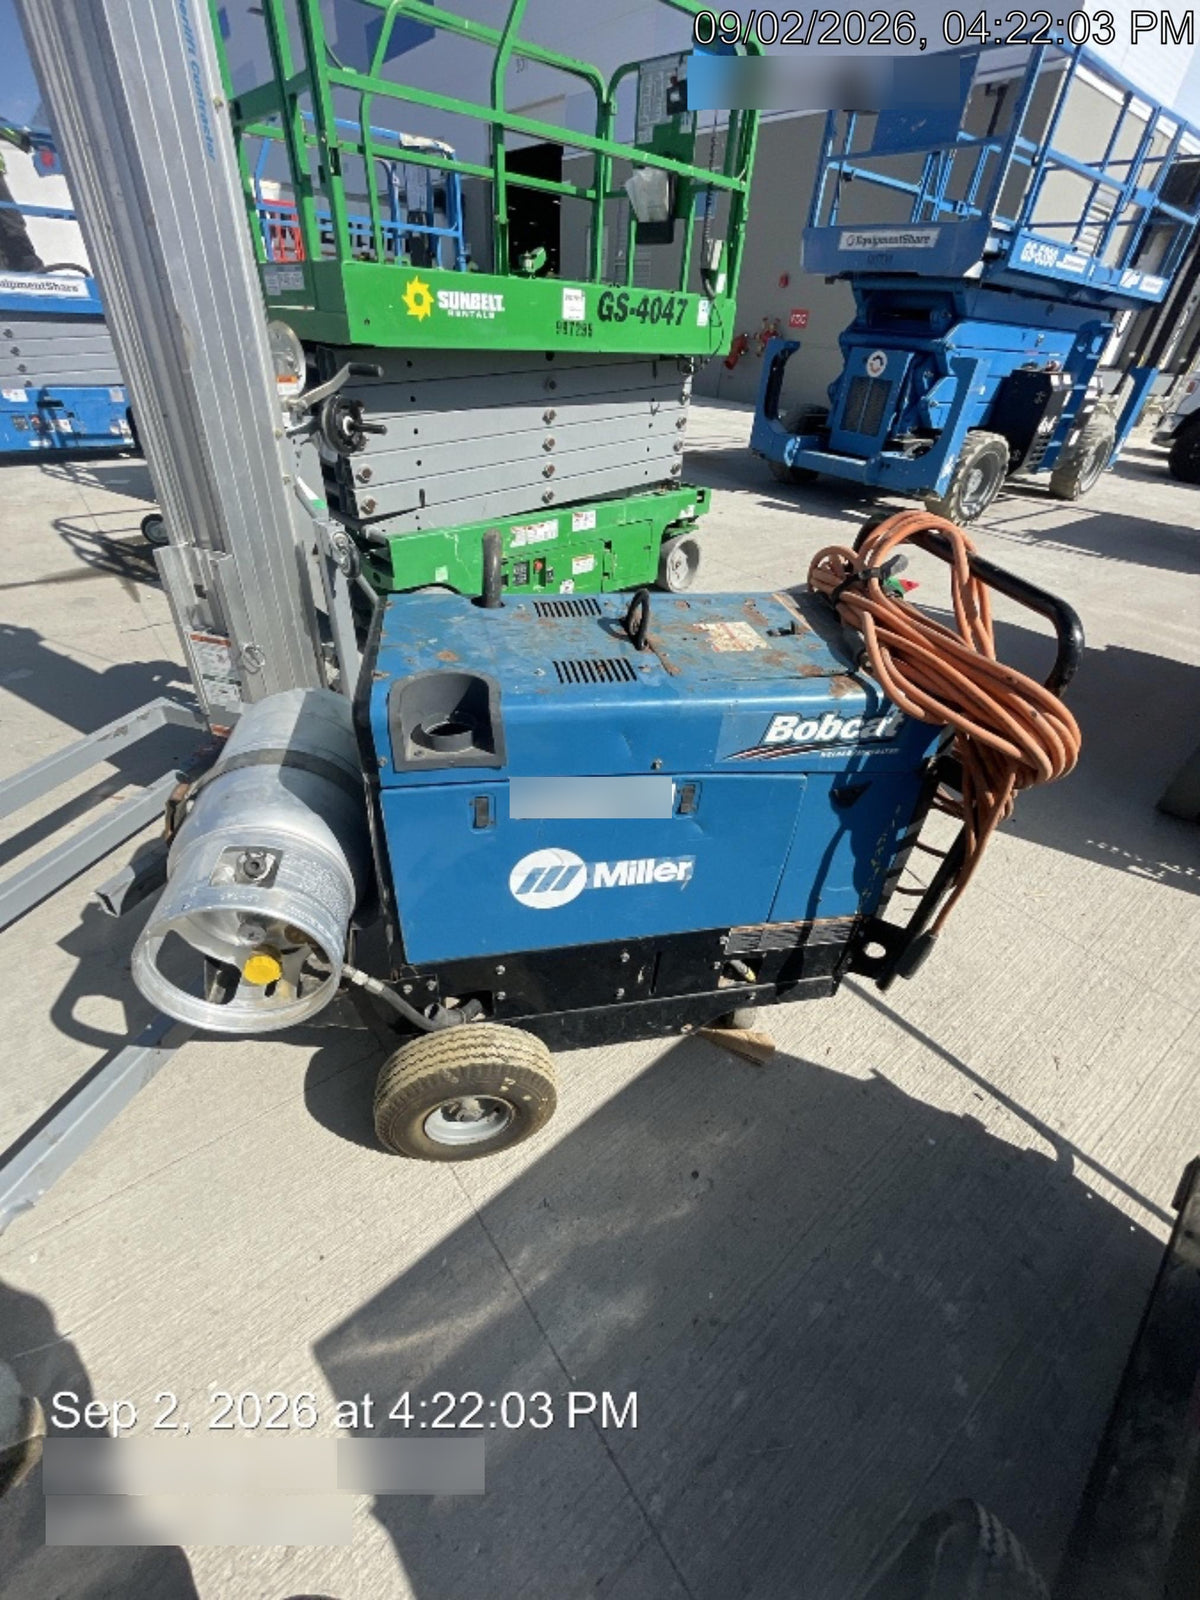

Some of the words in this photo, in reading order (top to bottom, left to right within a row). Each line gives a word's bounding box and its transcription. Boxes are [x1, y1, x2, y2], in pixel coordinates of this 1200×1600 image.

[437, 290, 504, 312] SUNBELT
[597, 290, 689, 326] GS-4047
[764, 712, 903, 742] Bobcat
[593, 858, 692, 888] Miller
